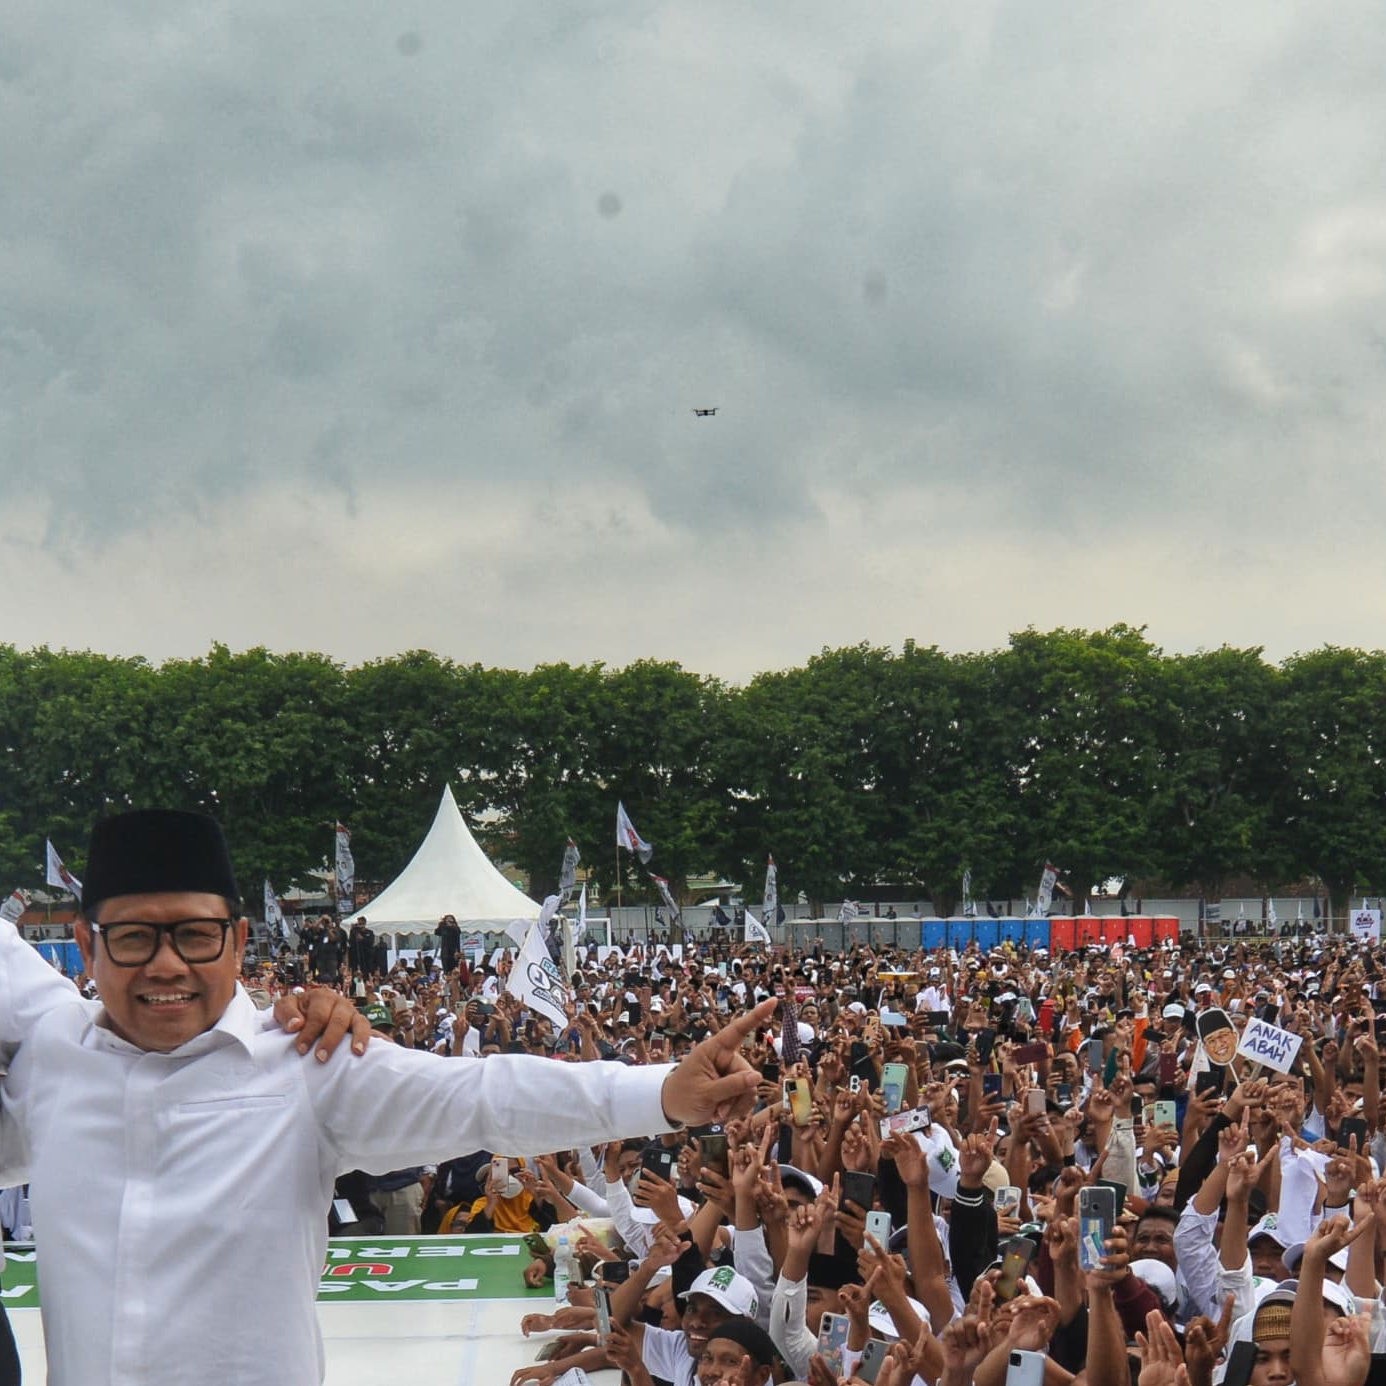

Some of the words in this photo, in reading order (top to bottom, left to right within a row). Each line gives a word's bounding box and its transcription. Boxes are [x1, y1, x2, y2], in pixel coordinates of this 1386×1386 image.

[1244, 1037, 1286, 1063] ABAH
[1250, 1023, 1294, 1052] ANAK
[708, 1280, 728, 1292] PKB
